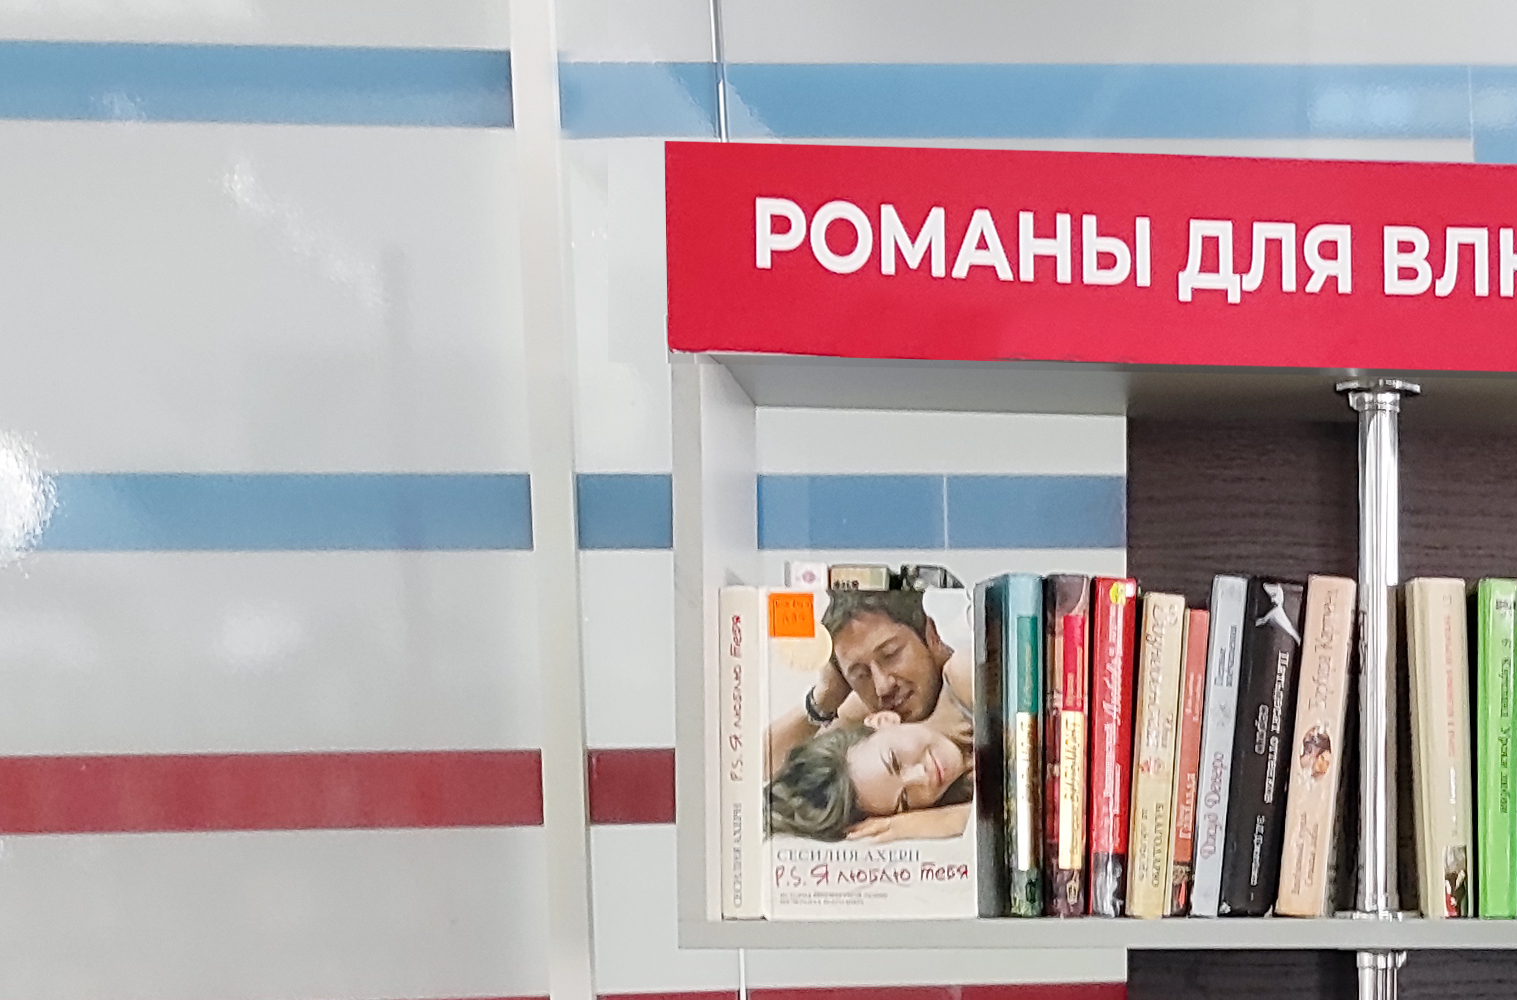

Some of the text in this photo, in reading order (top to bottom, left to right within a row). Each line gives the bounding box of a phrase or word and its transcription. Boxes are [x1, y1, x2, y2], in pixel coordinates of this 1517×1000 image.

[755, 197, 1151, 287] РОМАНЫ
[1177, 218, 1351, 304] ДЛЯ
[776, 849, 921, 863] СЕСИЛИЯ АХЕРН
[810, 863, 829, 885] Я
[920, 861, 969, 882] тебя
